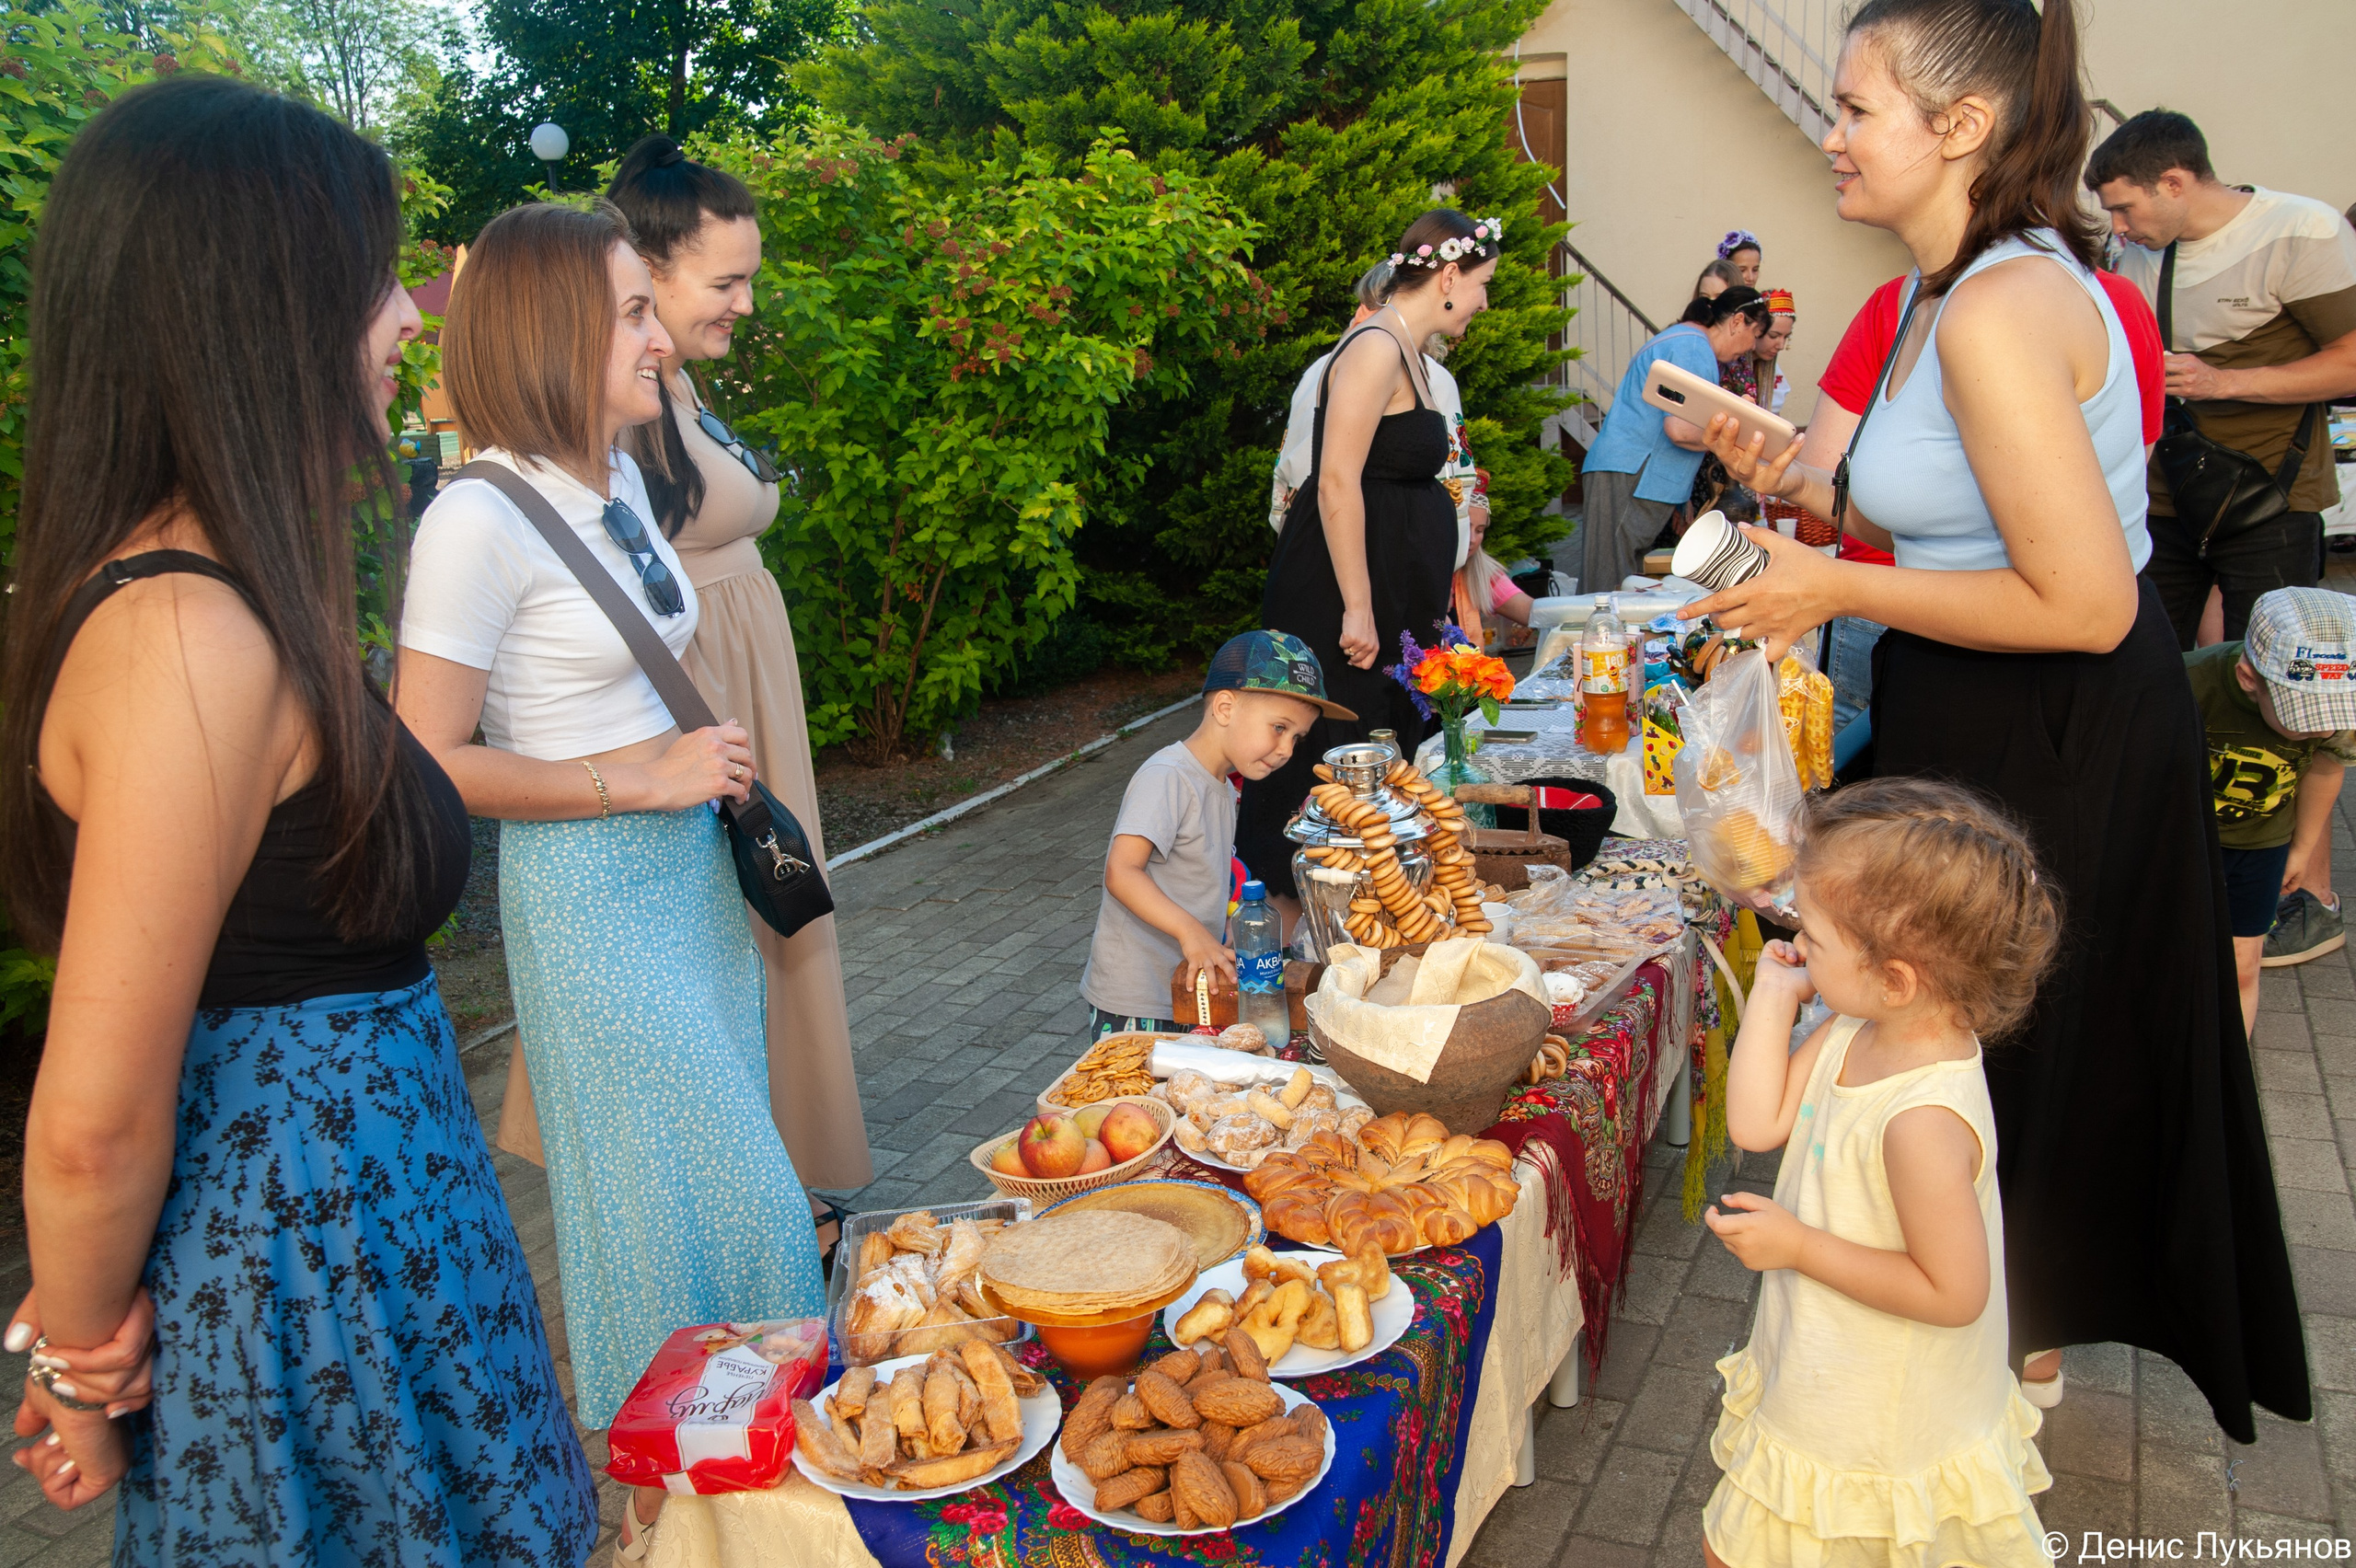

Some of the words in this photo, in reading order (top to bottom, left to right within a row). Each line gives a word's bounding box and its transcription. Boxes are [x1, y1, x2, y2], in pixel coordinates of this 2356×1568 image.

[1298, 663, 1315, 674] WILD
[2315, 663, 2350, 672] SPEED
[1297, 674, 1315, 686] CHILD
[2319, 672, 2345, 680] WAY
[1256, 952, 1283, 970] АКВА
[716, 1360, 768, 1376] КУРАБЬЕ
[727, 1371, 754, 1379] ПЕЧЕНЬЕ
